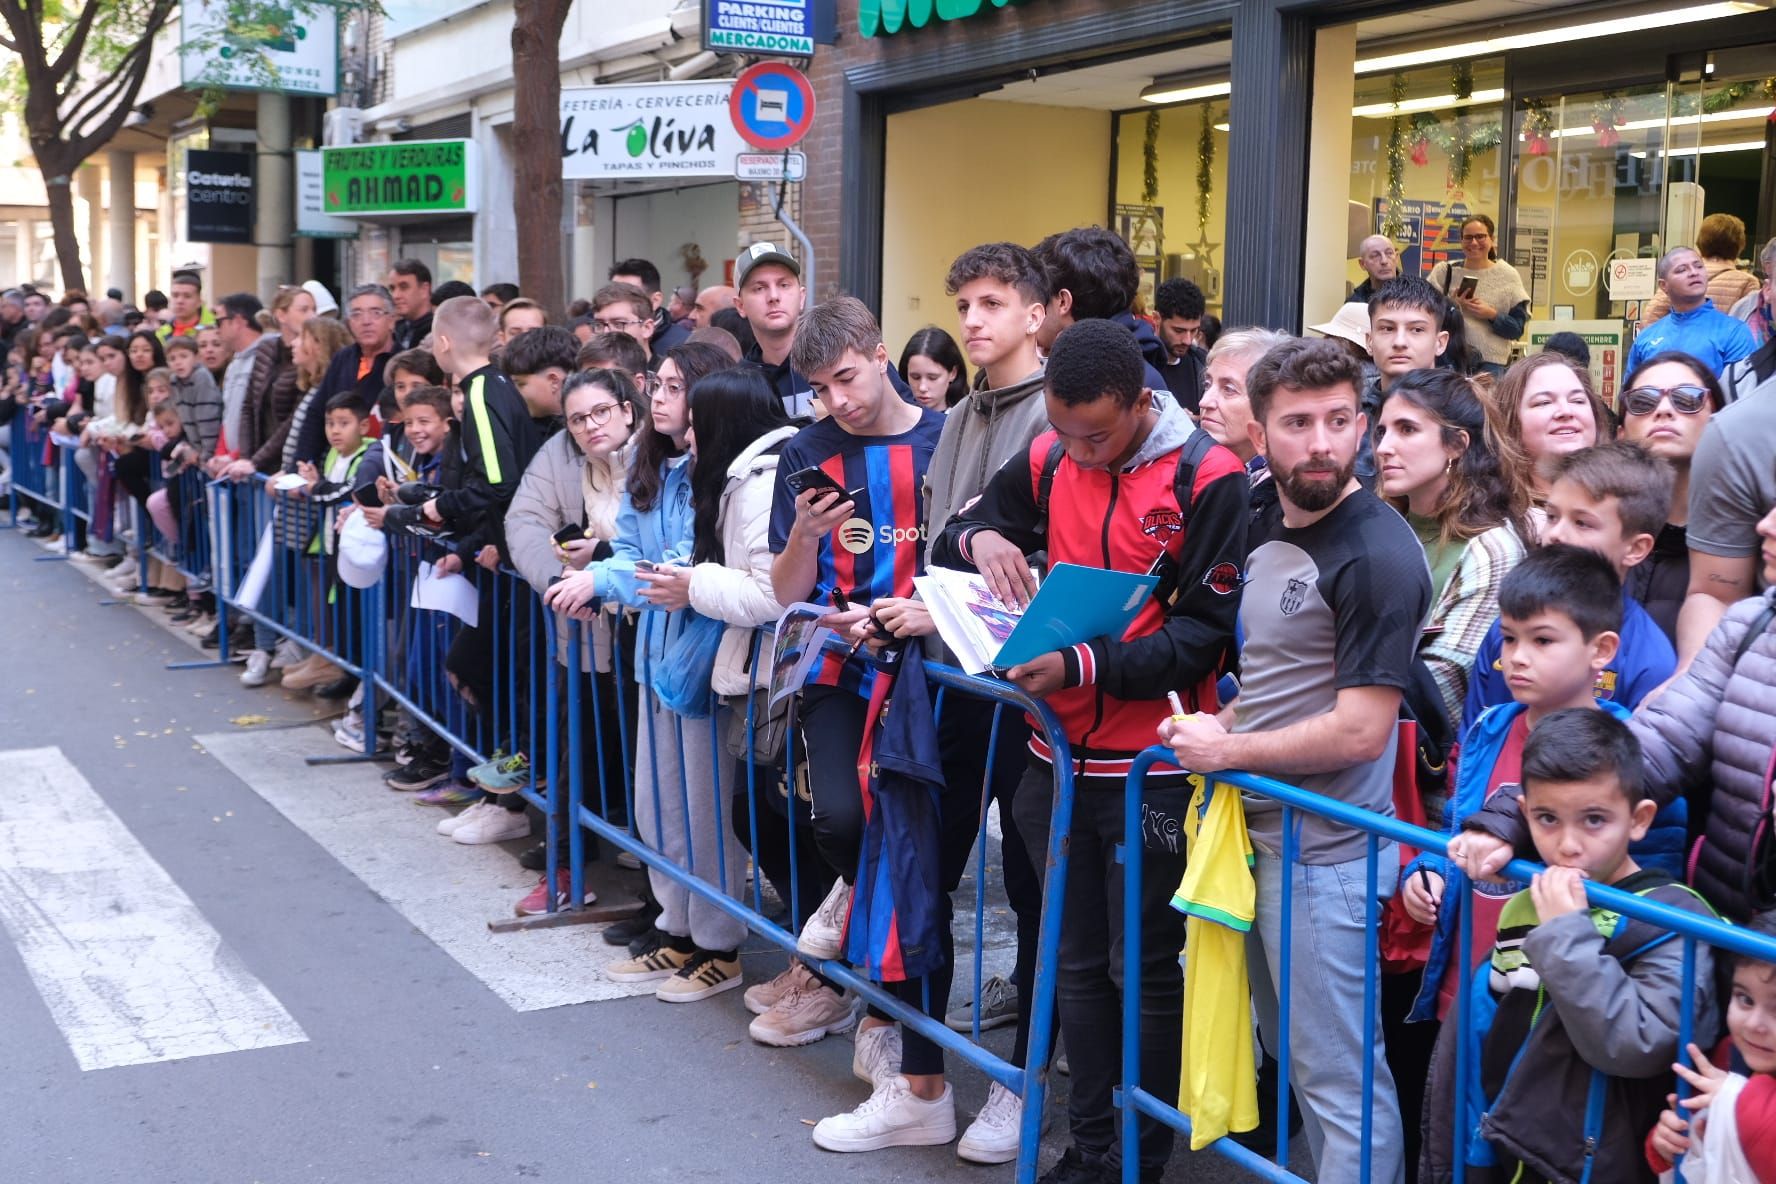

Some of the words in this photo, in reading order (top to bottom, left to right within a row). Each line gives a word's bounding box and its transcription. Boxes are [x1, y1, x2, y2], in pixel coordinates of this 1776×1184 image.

[718, 2, 805, 21] PARKING
[711, 31, 811, 51] MERCADONA
[563, 98, 623, 112] FETERÍA
[561, 115, 600, 158] La
[328, 150, 374, 171] FRUTAS
[379, 150, 387, 169] Y
[392, 146, 462, 168] VERDURAS
[602, 161, 643, 171] TAPAS
[647, 161, 655, 169] Y
[659, 159, 716, 169] PINCHOS
[189, 171, 252, 187] Caturla
[189, 189, 249, 205] centro
[349, 174, 443, 204] AHMAD
[1585, 336, 1613, 344] CIEMBRE
[879, 525, 928, 547] Spot
